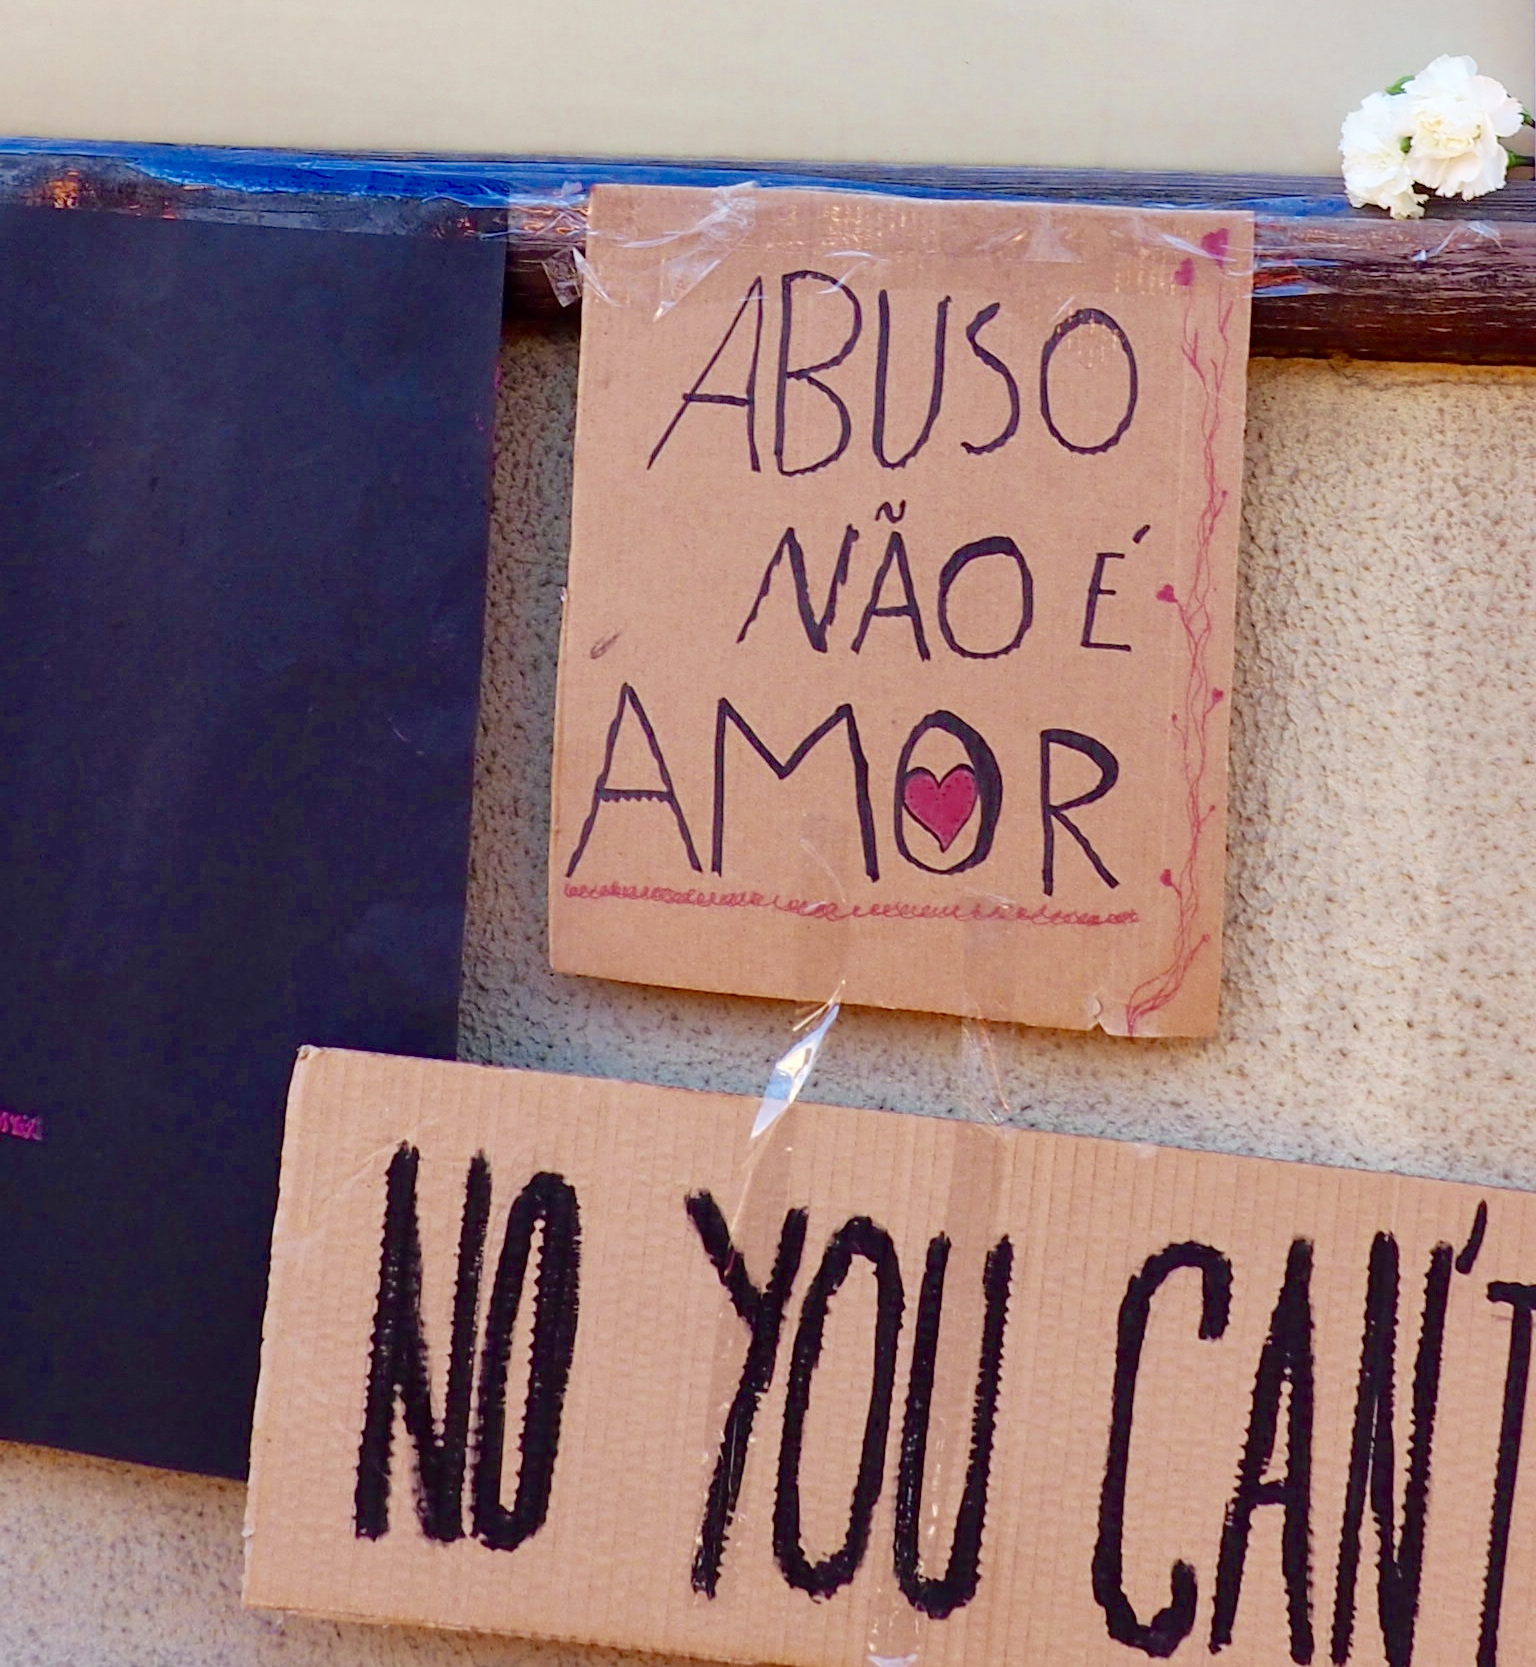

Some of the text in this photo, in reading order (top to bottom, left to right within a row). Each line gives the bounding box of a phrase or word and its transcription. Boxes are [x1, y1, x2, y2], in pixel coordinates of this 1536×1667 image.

[647, 269, 1139, 477] ABUSO
[737, 500, 1151, 661] NÃO É
[567, 683, 1120, 896] AMOR
[354, 1141, 582, 1550] NO
[684, 1187, 1013, 1619] YOU
